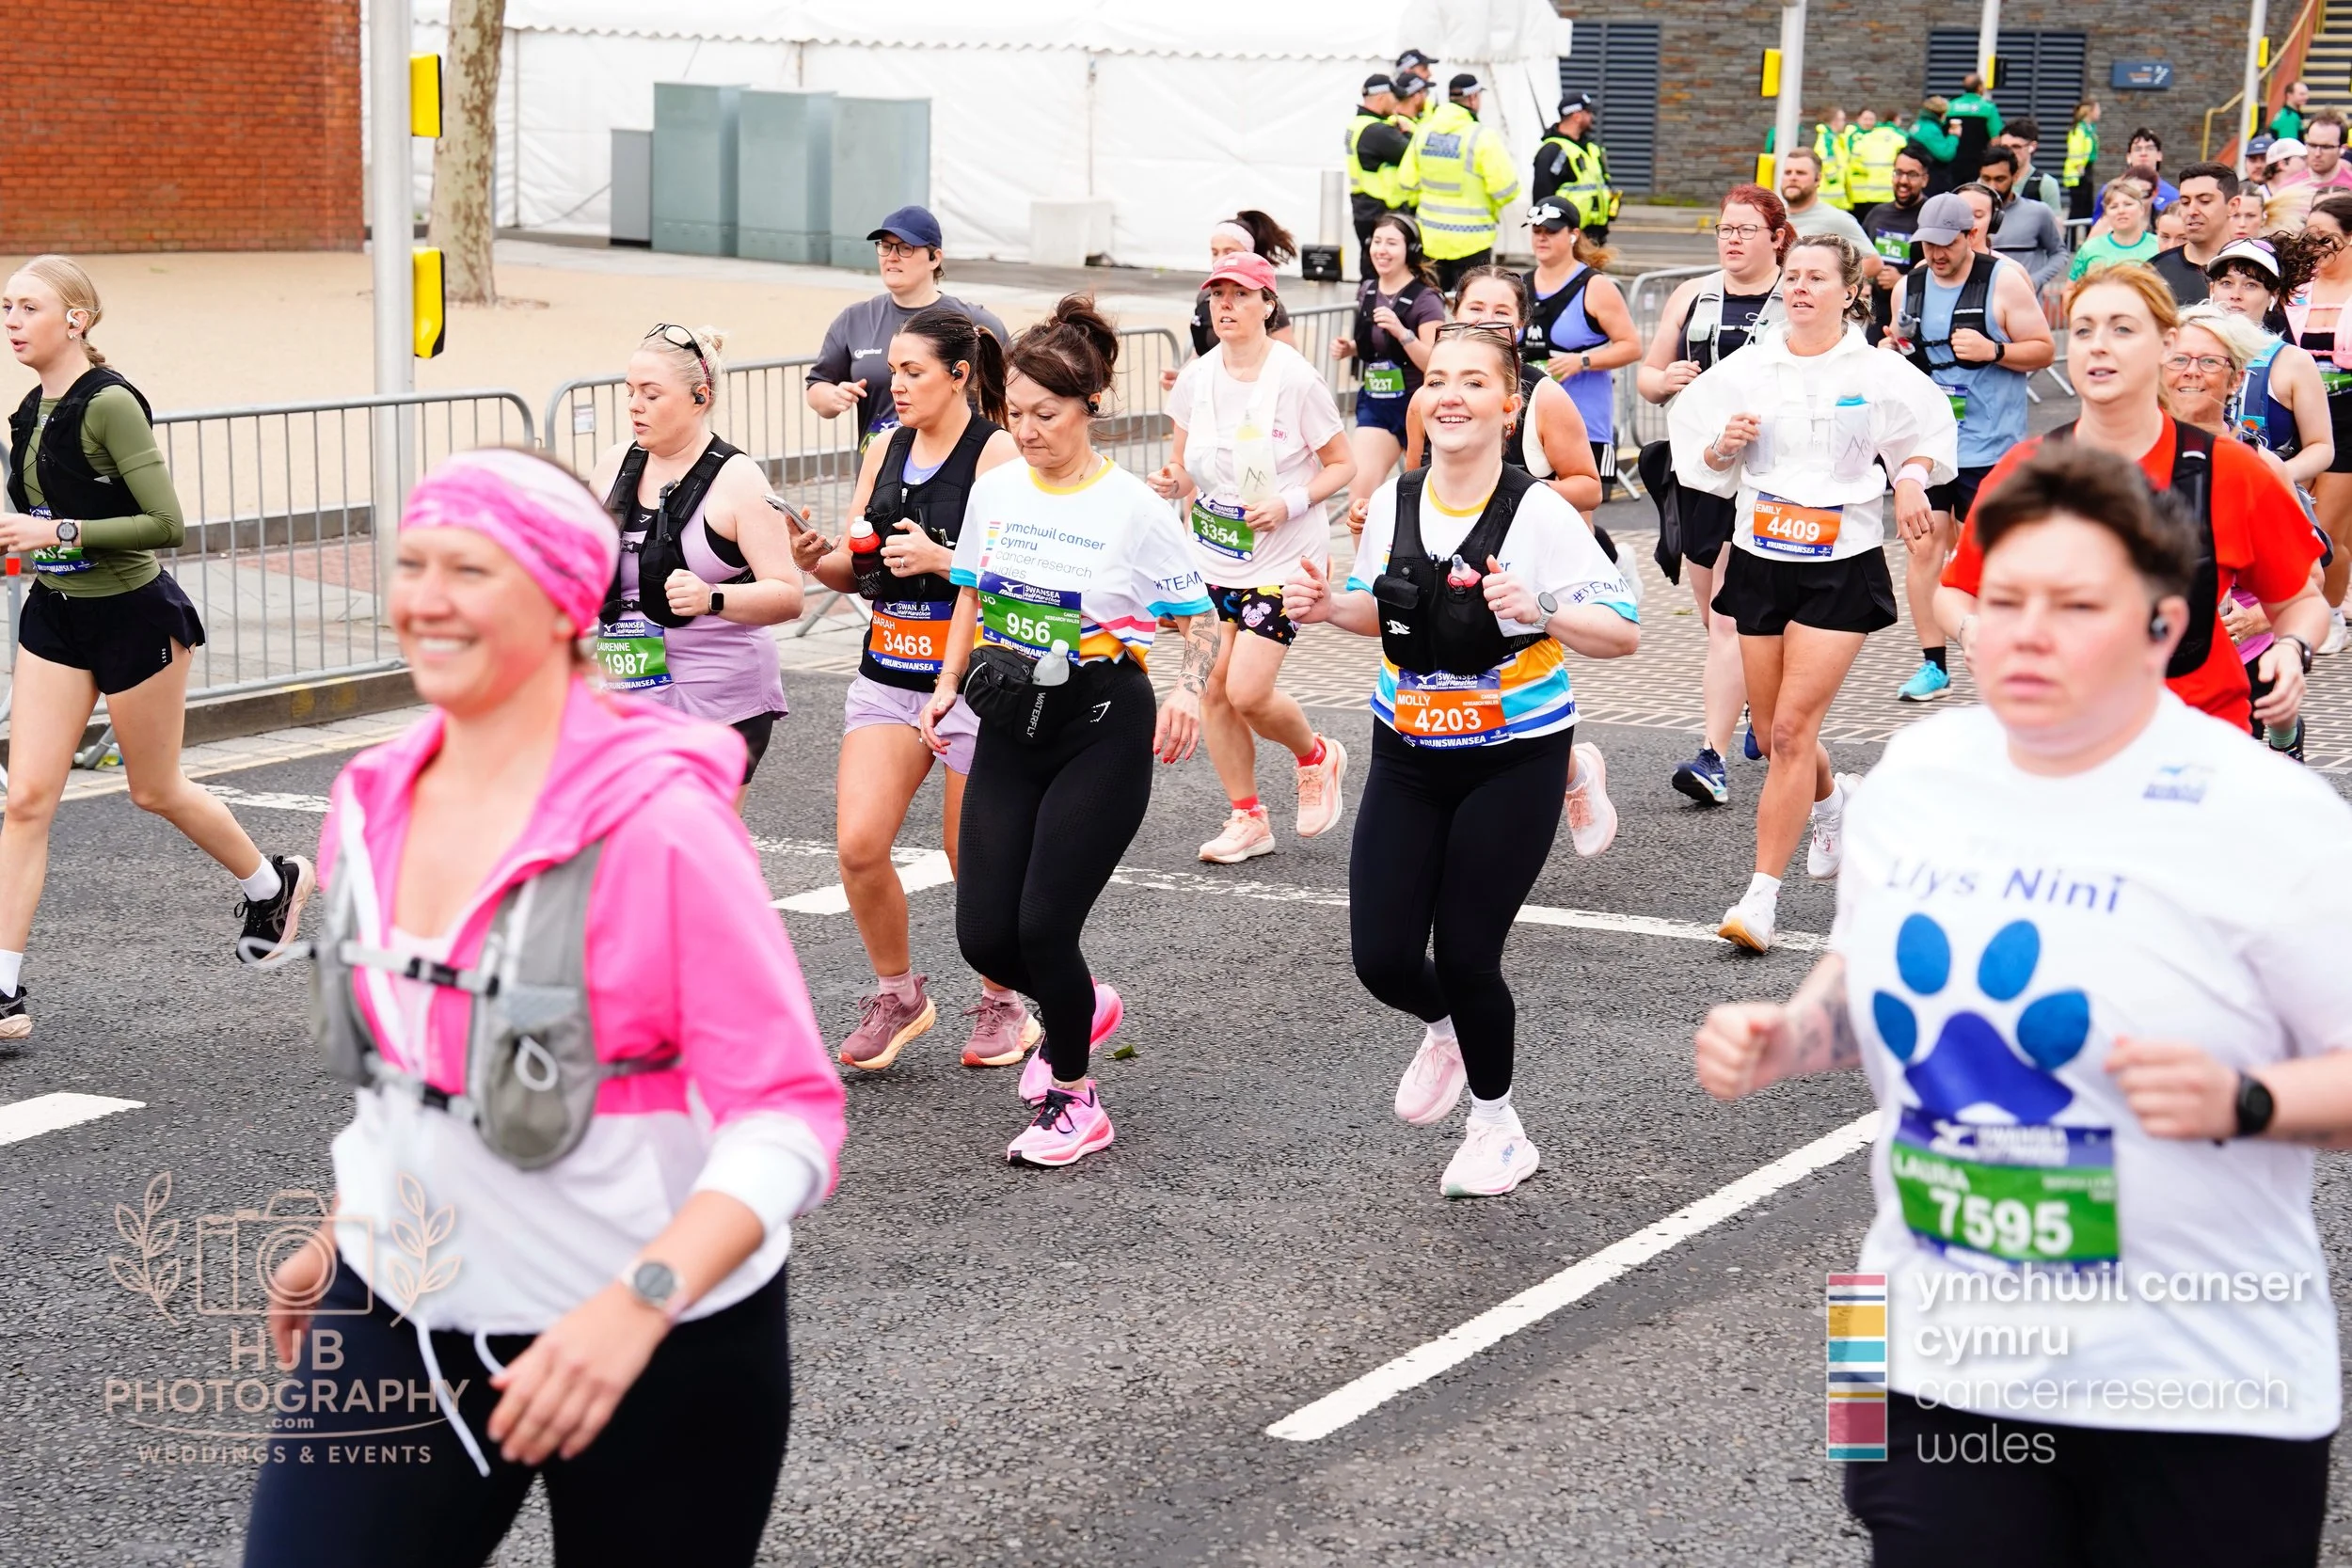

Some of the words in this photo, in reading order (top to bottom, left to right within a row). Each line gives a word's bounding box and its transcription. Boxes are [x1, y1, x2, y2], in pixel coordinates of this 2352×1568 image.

[1756, 503, 1782, 515] EMILY
[1005, 522, 1057, 540] ymchwil
[1058, 531, 1106, 551] canser
[1200, 520, 1239, 546] 3354
[1767, 516, 1820, 542] 4409
[1000, 536, 1039, 551] cymru
[991, 564, 1027, 579] wales
[995, 549, 1037, 564] cancer
[1037, 556, 1092, 578] research
[982, 595, 996, 605] JO
[1025, 585, 1060, 599] SWANSEA
[898, 603, 930, 611] SWANEA
[873, 614, 896, 630] SARAH
[1007, 612, 1051, 643] 956
[883, 630, 932, 657] 3468
[1000, 637, 1051, 658] #RUNSWANS
[605, 653, 648, 674] 1987
[881, 657, 934, 671] #RUNSWANSEA
[608, 678, 656, 689] RUNSWANSEA
[1397, 694, 1430, 706] MOLLY
[1026, 692, 1046, 738] WATERFLY
[1414, 707, 1482, 732] 4203
[1420, 735, 1486, 748] #RUNSWANSEA
[1929, 1185, 2074, 1256] 7595
